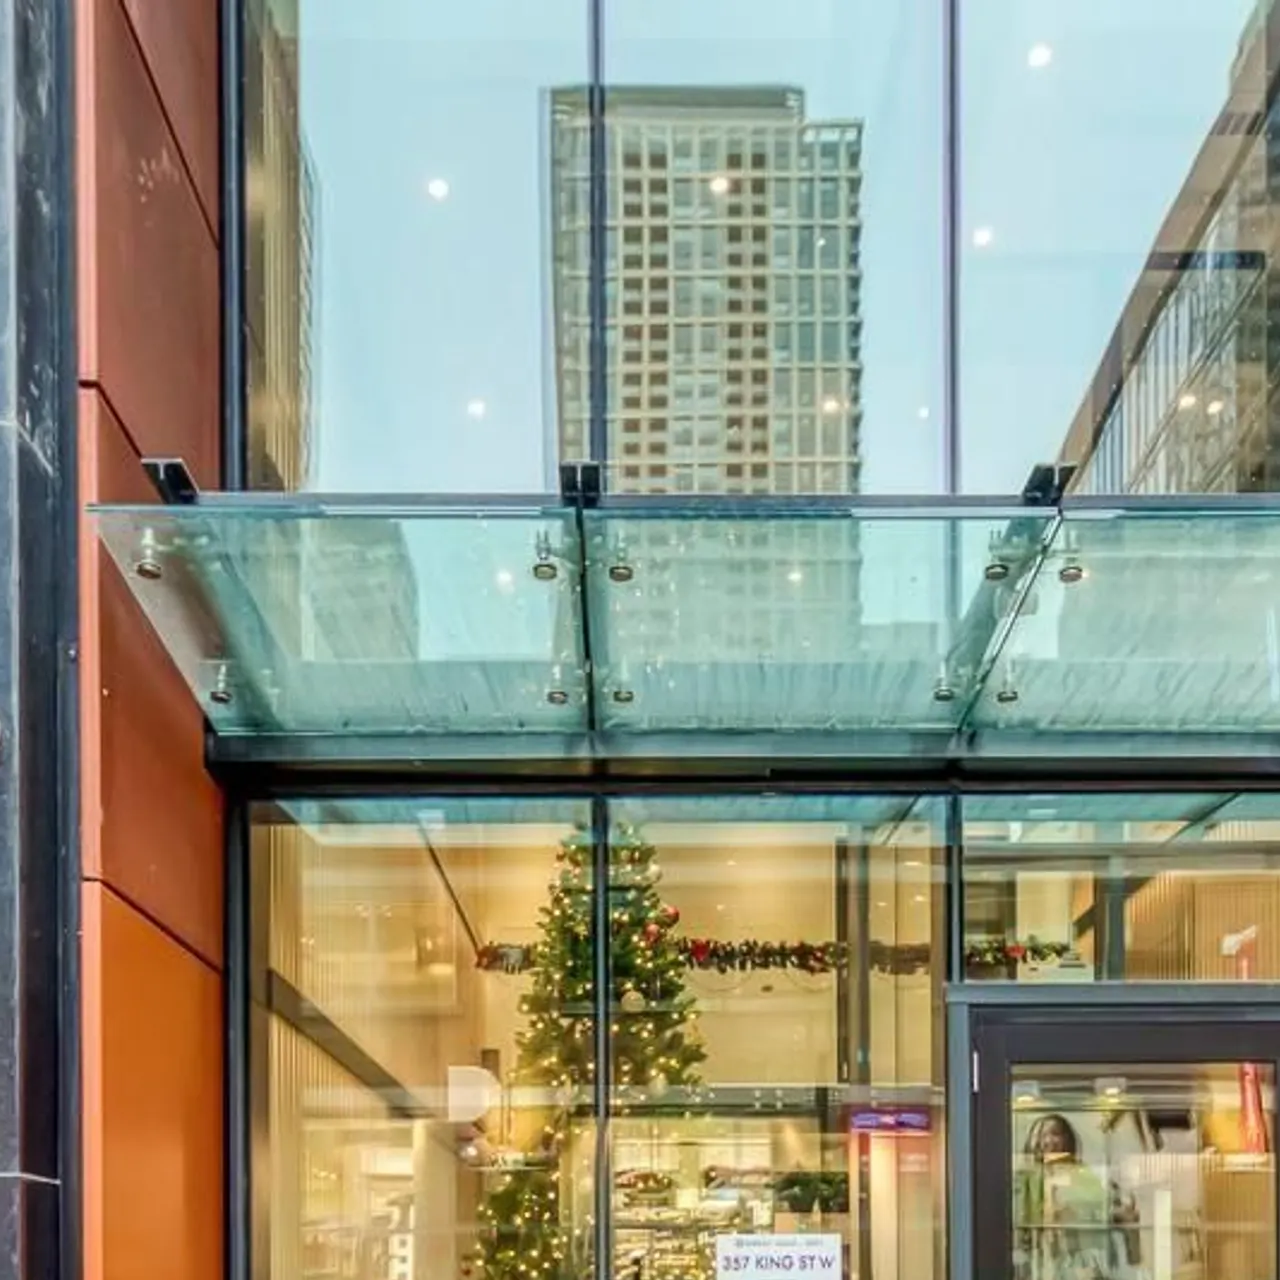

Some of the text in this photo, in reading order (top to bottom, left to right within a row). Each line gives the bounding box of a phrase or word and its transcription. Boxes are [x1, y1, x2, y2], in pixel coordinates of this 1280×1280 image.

[722, 1254, 834, 1271] 357 KING ST W
